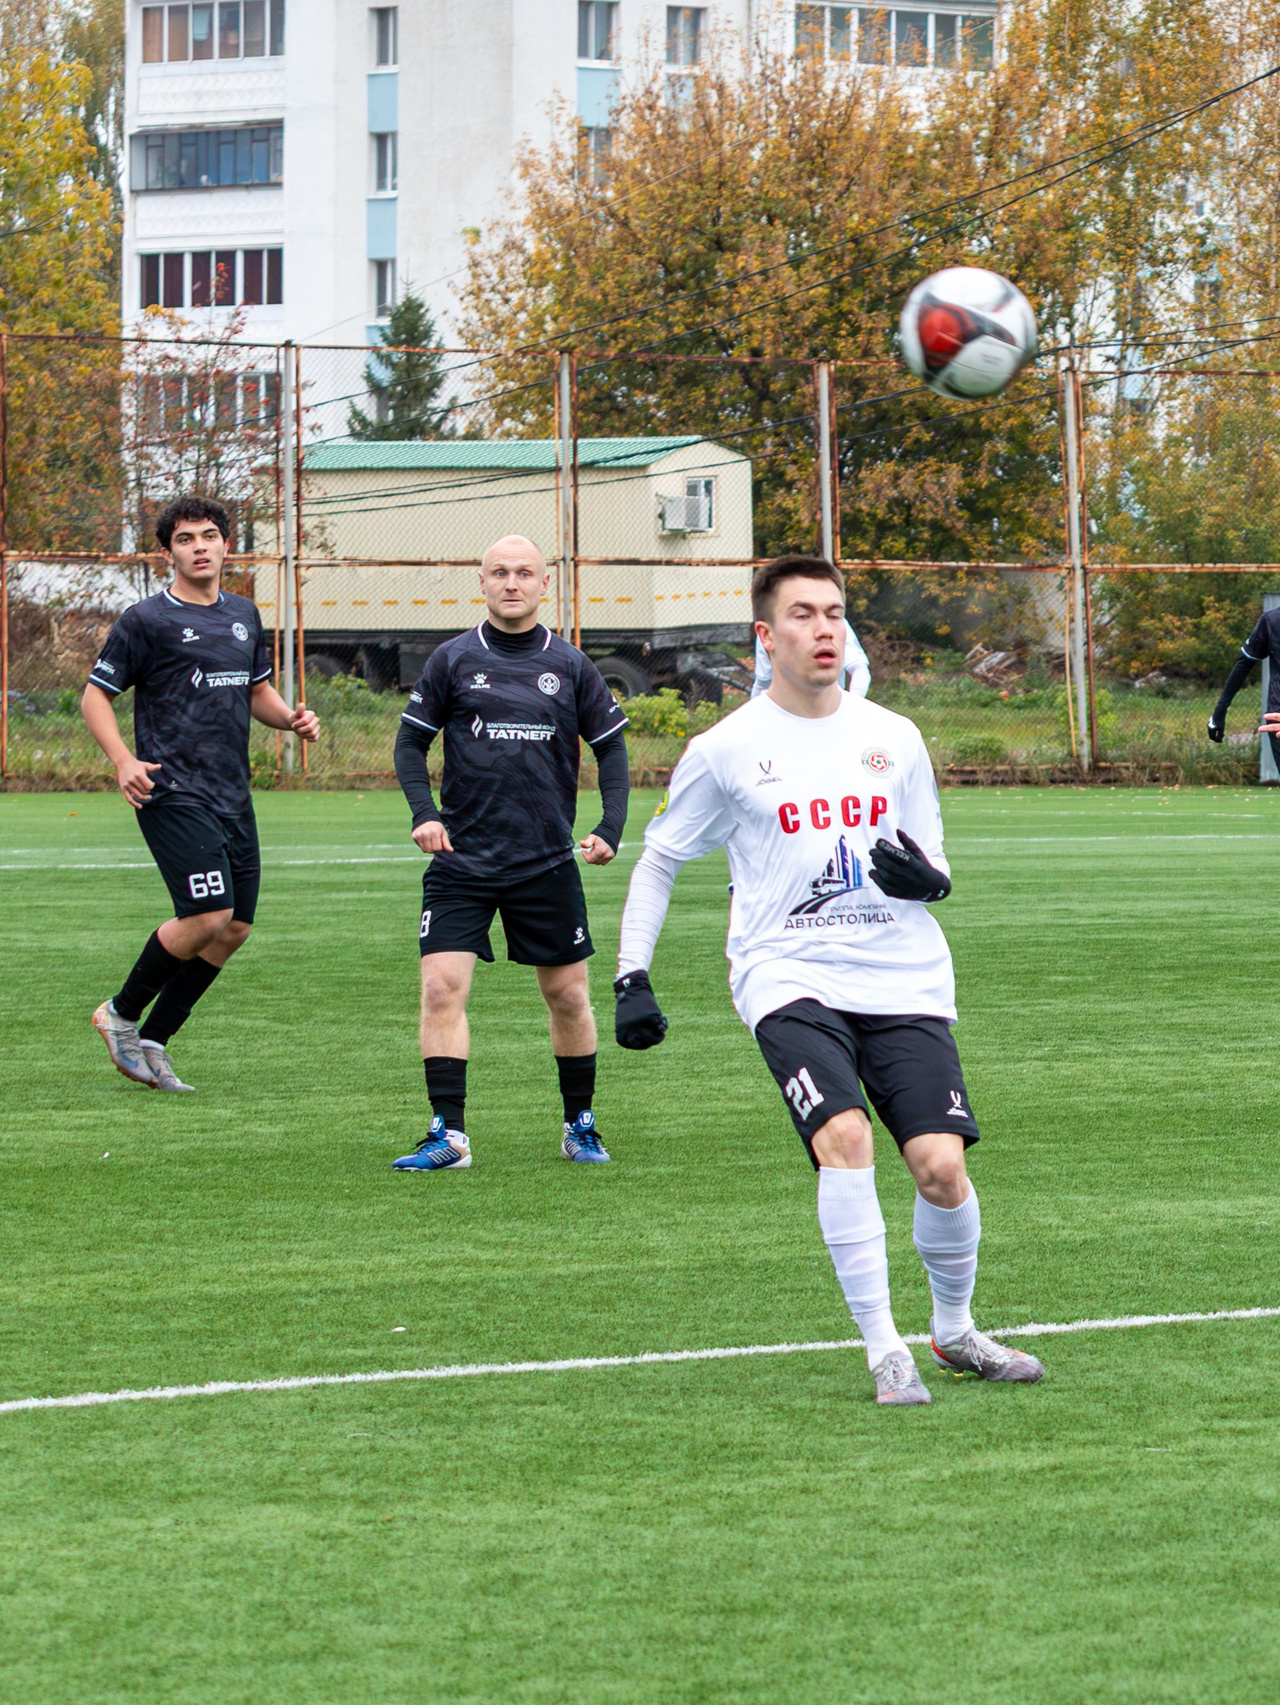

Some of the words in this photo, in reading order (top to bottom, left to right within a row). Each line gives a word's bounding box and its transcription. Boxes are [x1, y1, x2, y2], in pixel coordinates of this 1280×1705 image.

[206, 676, 250, 688] TATNEFT
[486, 729, 555, 741] TATNEFT
[778, 795, 888, 835] СССР
[188, 870, 226, 899] 69
[784, 912, 896, 930] АВТОСТОЛИЦА
[785, 1066, 825, 1121] 21
